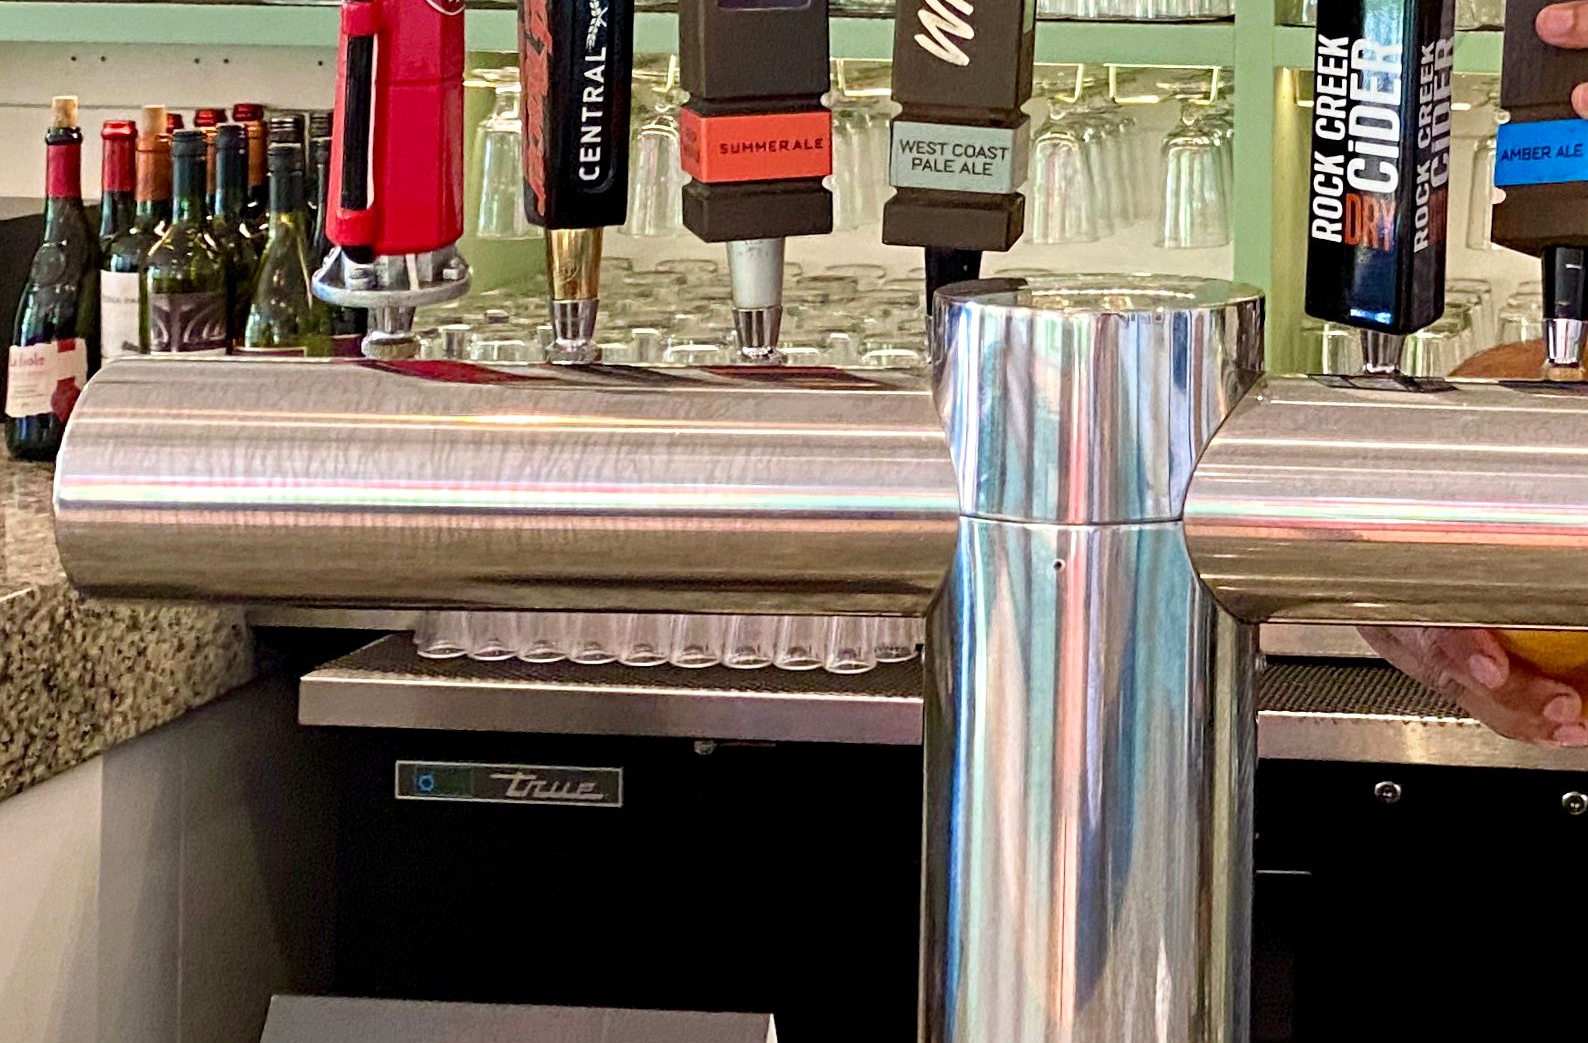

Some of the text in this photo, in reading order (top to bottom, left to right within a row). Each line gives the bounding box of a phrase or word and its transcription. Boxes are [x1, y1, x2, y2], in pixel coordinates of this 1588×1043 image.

[578, 46, 608, 182] CENTRAL
[1311, 33, 1350, 244] ROCK CREEK
[899, 139, 1010, 161] WEST COAST
[911, 157, 994, 177] PALE ALE
[1413, 41, 1436, 254] ROCK CREEK
[1500, 143, 1584, 162] AMBER ALE
[1344, 192, 1396, 252] DRY
